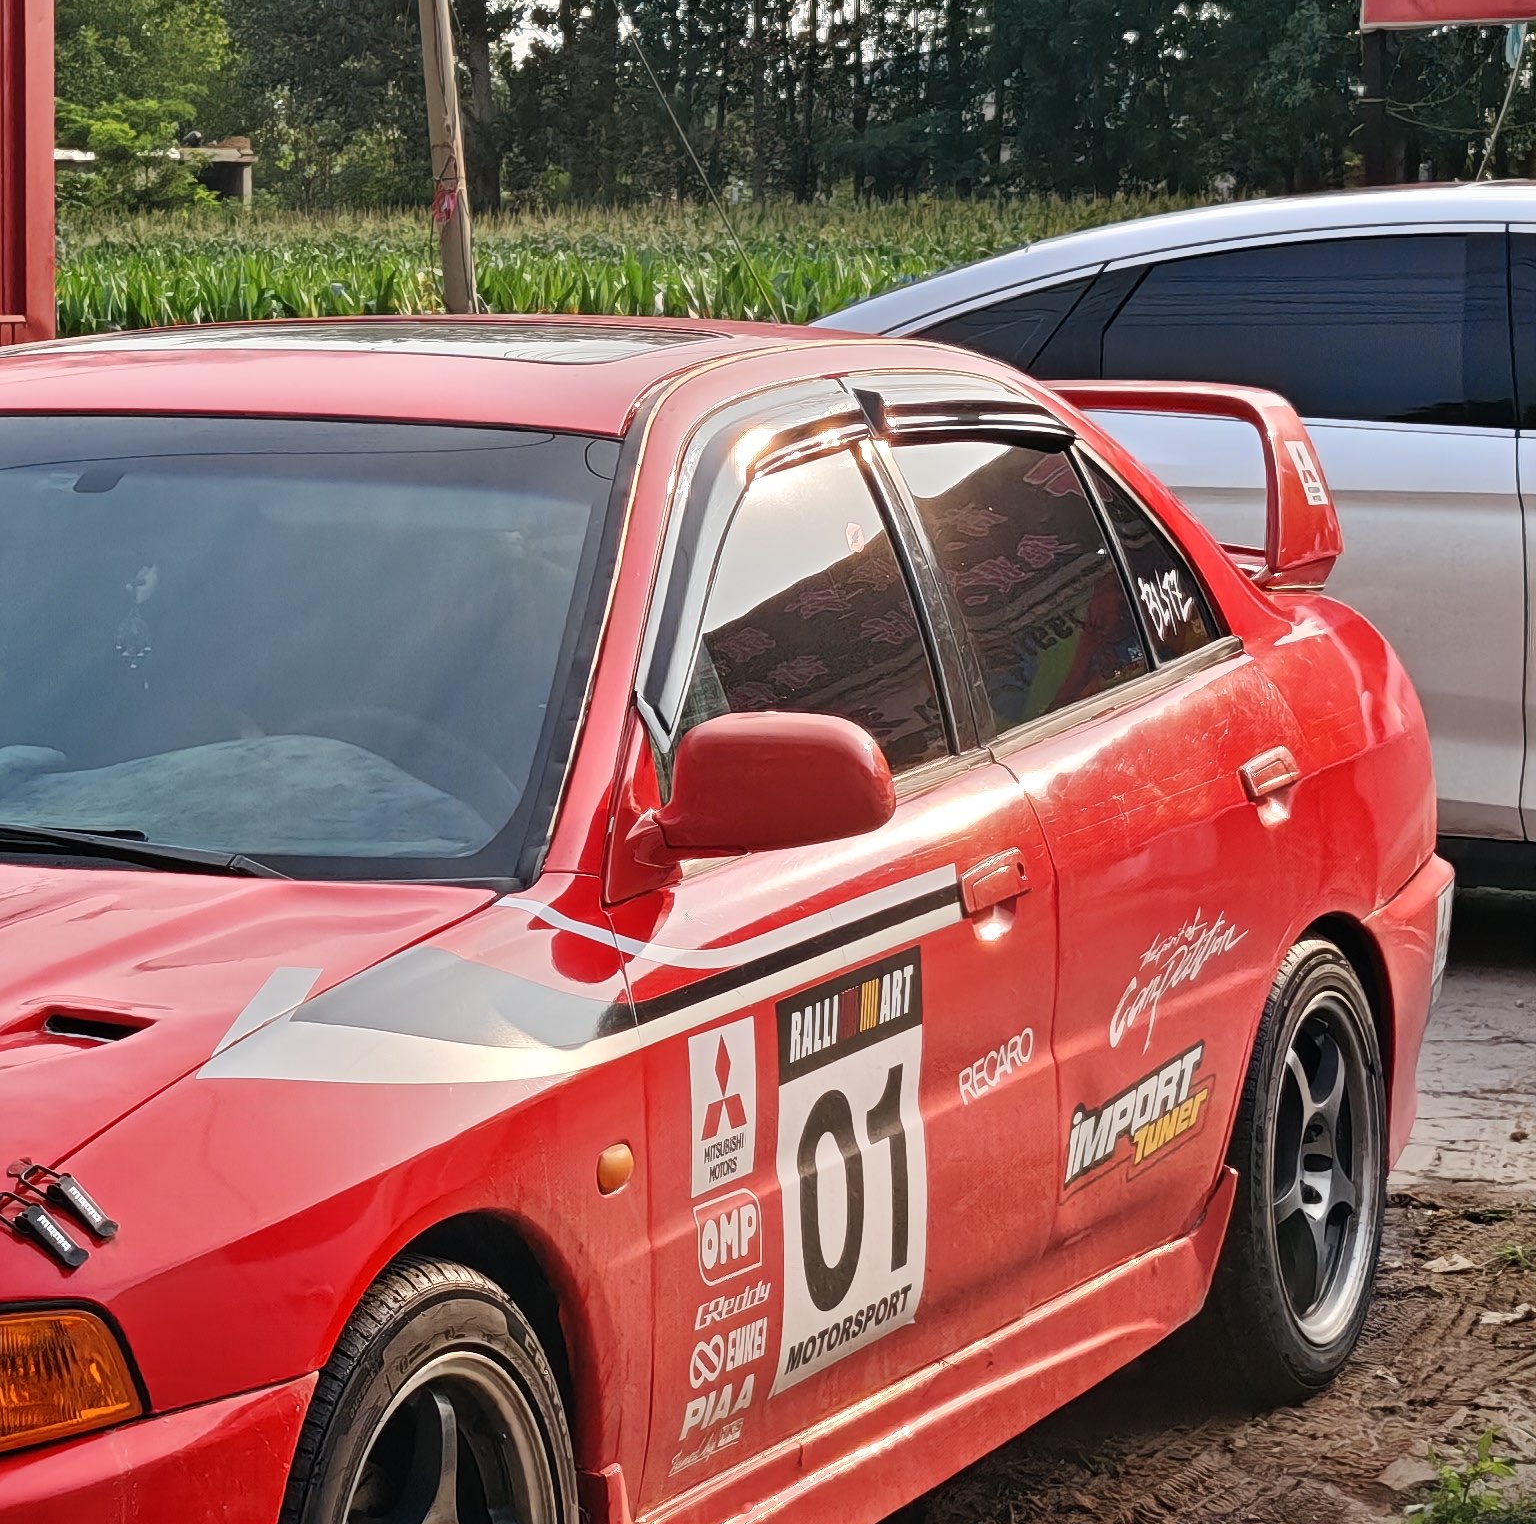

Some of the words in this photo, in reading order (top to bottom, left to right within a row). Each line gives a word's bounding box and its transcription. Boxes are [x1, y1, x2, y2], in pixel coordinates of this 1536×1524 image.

[959, 1027, 1034, 1106] RECARO
[703, 1132, 745, 1165] MITSUBISHI
[708, 1156, 738, 1184] MOTORS
[797, 1063, 909, 1312] 01
[701, 1203, 757, 1270] OMP
[784, 1283, 913, 1375] MOTORSPORT
[678, 1373, 755, 1442] PIAA
